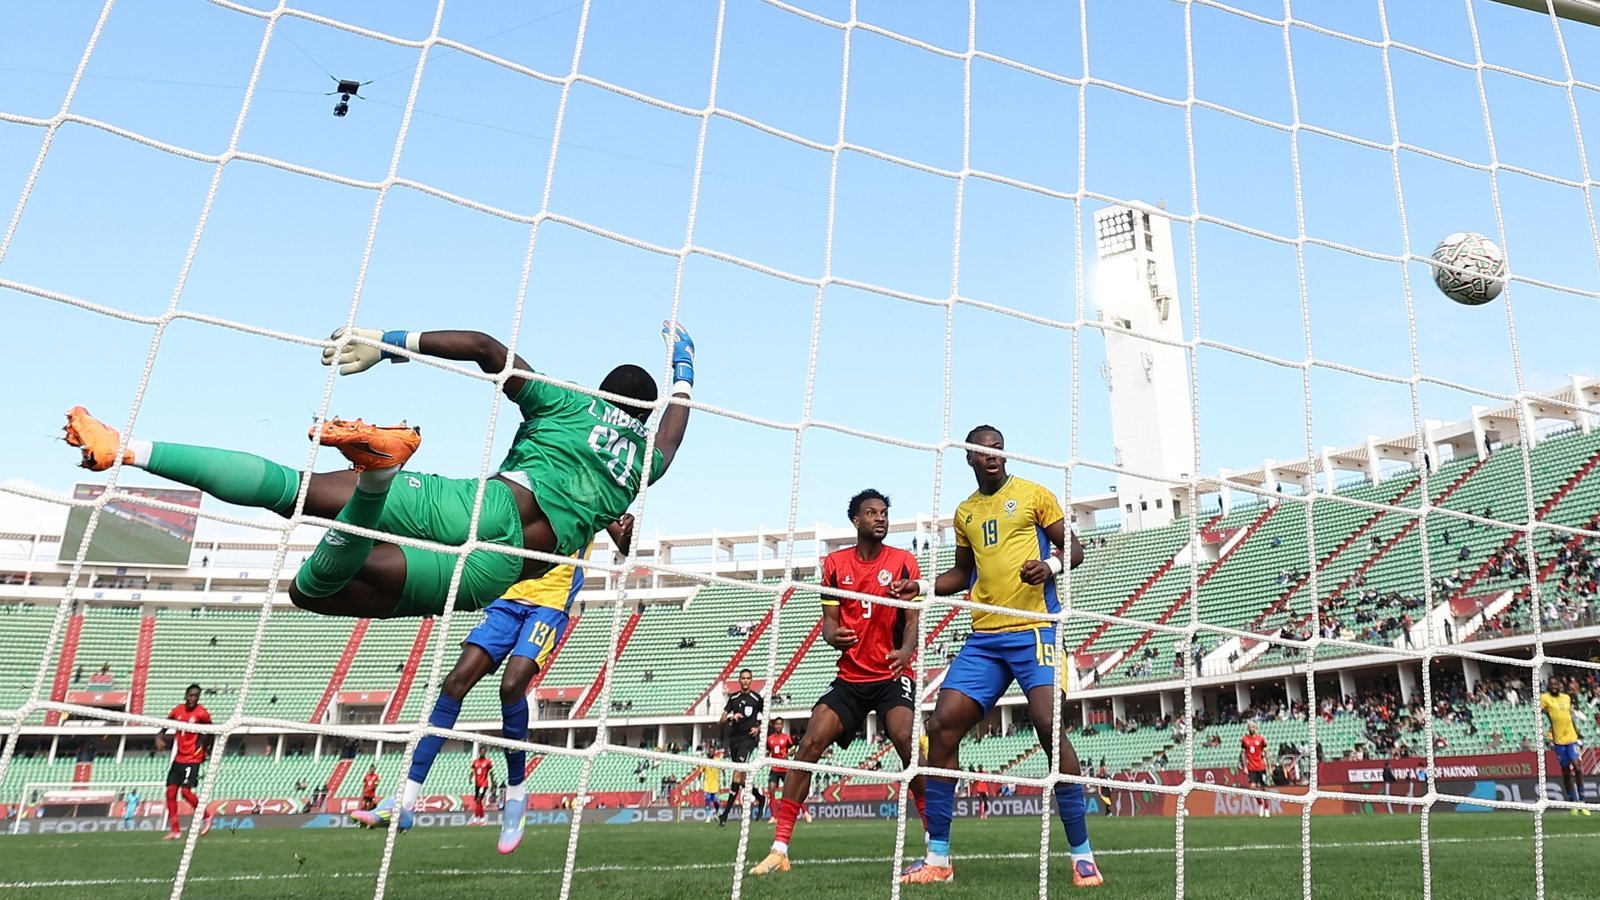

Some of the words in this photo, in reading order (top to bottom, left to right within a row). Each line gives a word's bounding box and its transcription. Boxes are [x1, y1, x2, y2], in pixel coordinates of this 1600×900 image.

[981, 518, 999, 548] 19
[861, 597, 872, 619] 9
[527, 620, 550, 647] 13
[1037, 643, 1057, 667] 19
[900, 675, 912, 693] 9
[1444, 765, 1478, 778] NATIONS
[1478, 766, 1520, 776] MOROCCO
[819, 804, 876, 818] FOOTBALL
